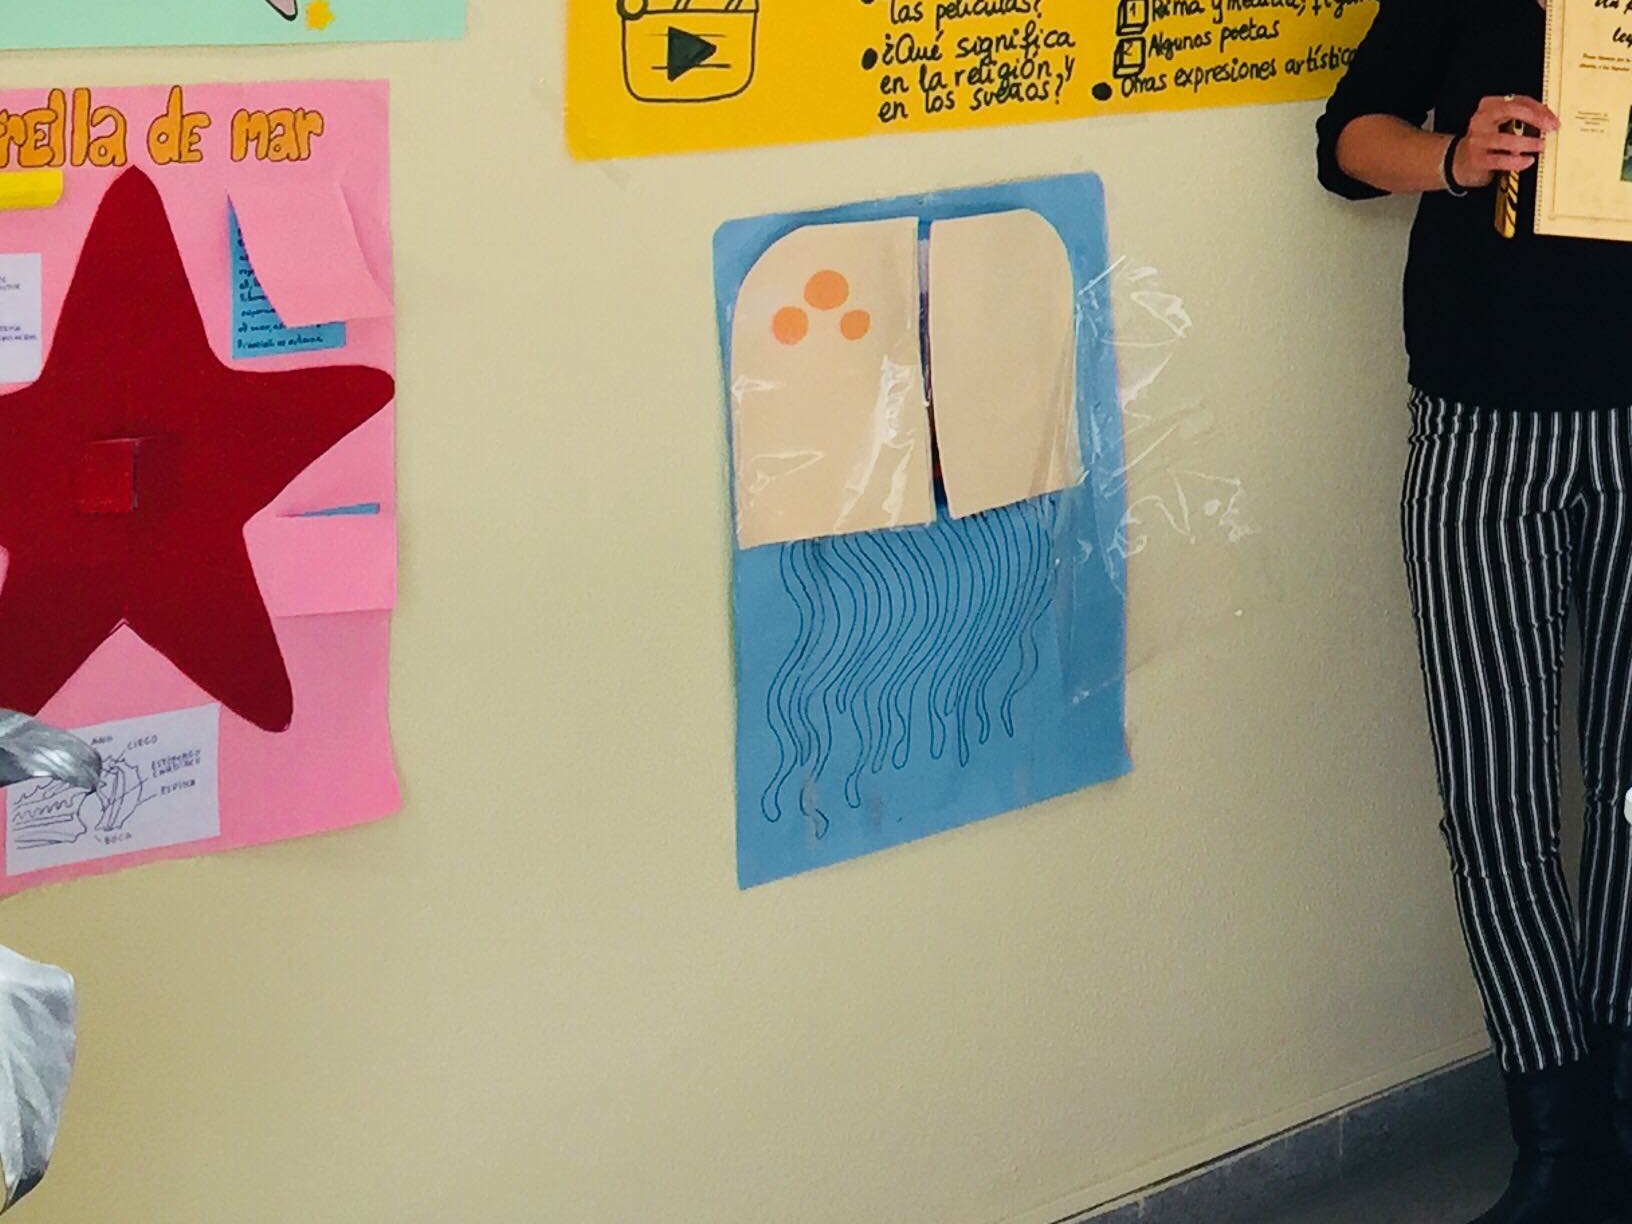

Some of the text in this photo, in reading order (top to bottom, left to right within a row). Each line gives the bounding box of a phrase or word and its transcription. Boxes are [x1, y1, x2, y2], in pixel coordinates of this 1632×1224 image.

[881, 19, 1077, 66] ¿Qué significa
[1148, 19, 1281, 61] Algunos poetas
[880, 74, 910, 95] en
[919, 63, 948, 93] la
[1174, 57, 1277, 93] expresiones
[146, 84, 212, 165] de
[230, 107, 325, 162] mar
[878, 99, 909, 123] en
